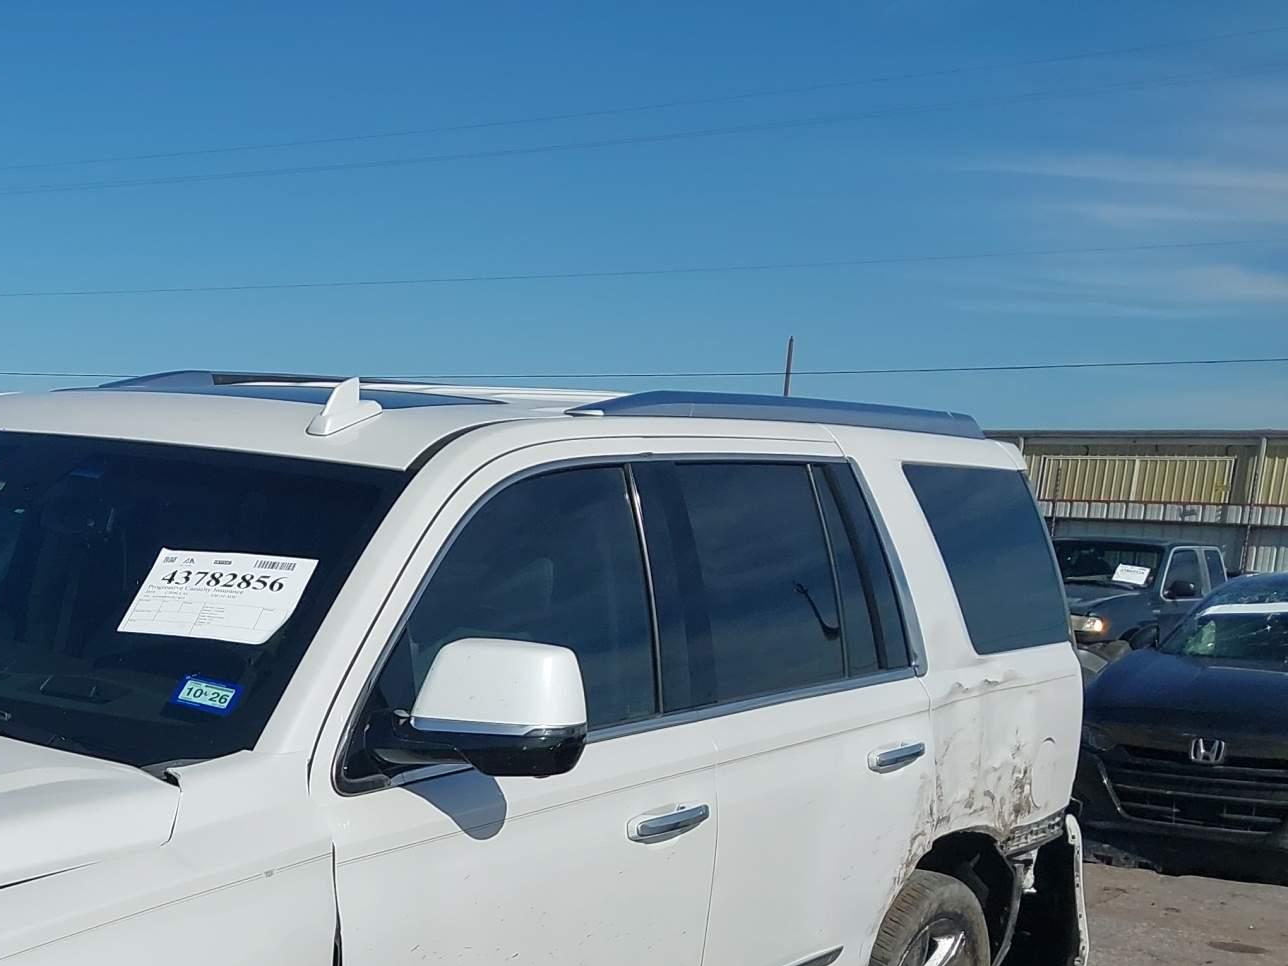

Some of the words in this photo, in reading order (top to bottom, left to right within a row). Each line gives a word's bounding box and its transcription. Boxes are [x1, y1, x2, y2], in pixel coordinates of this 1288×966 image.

[161, 569, 289, 593] 43782856
[186, 686, 204, 699] 10
[208, 691, 230, 704] 26
